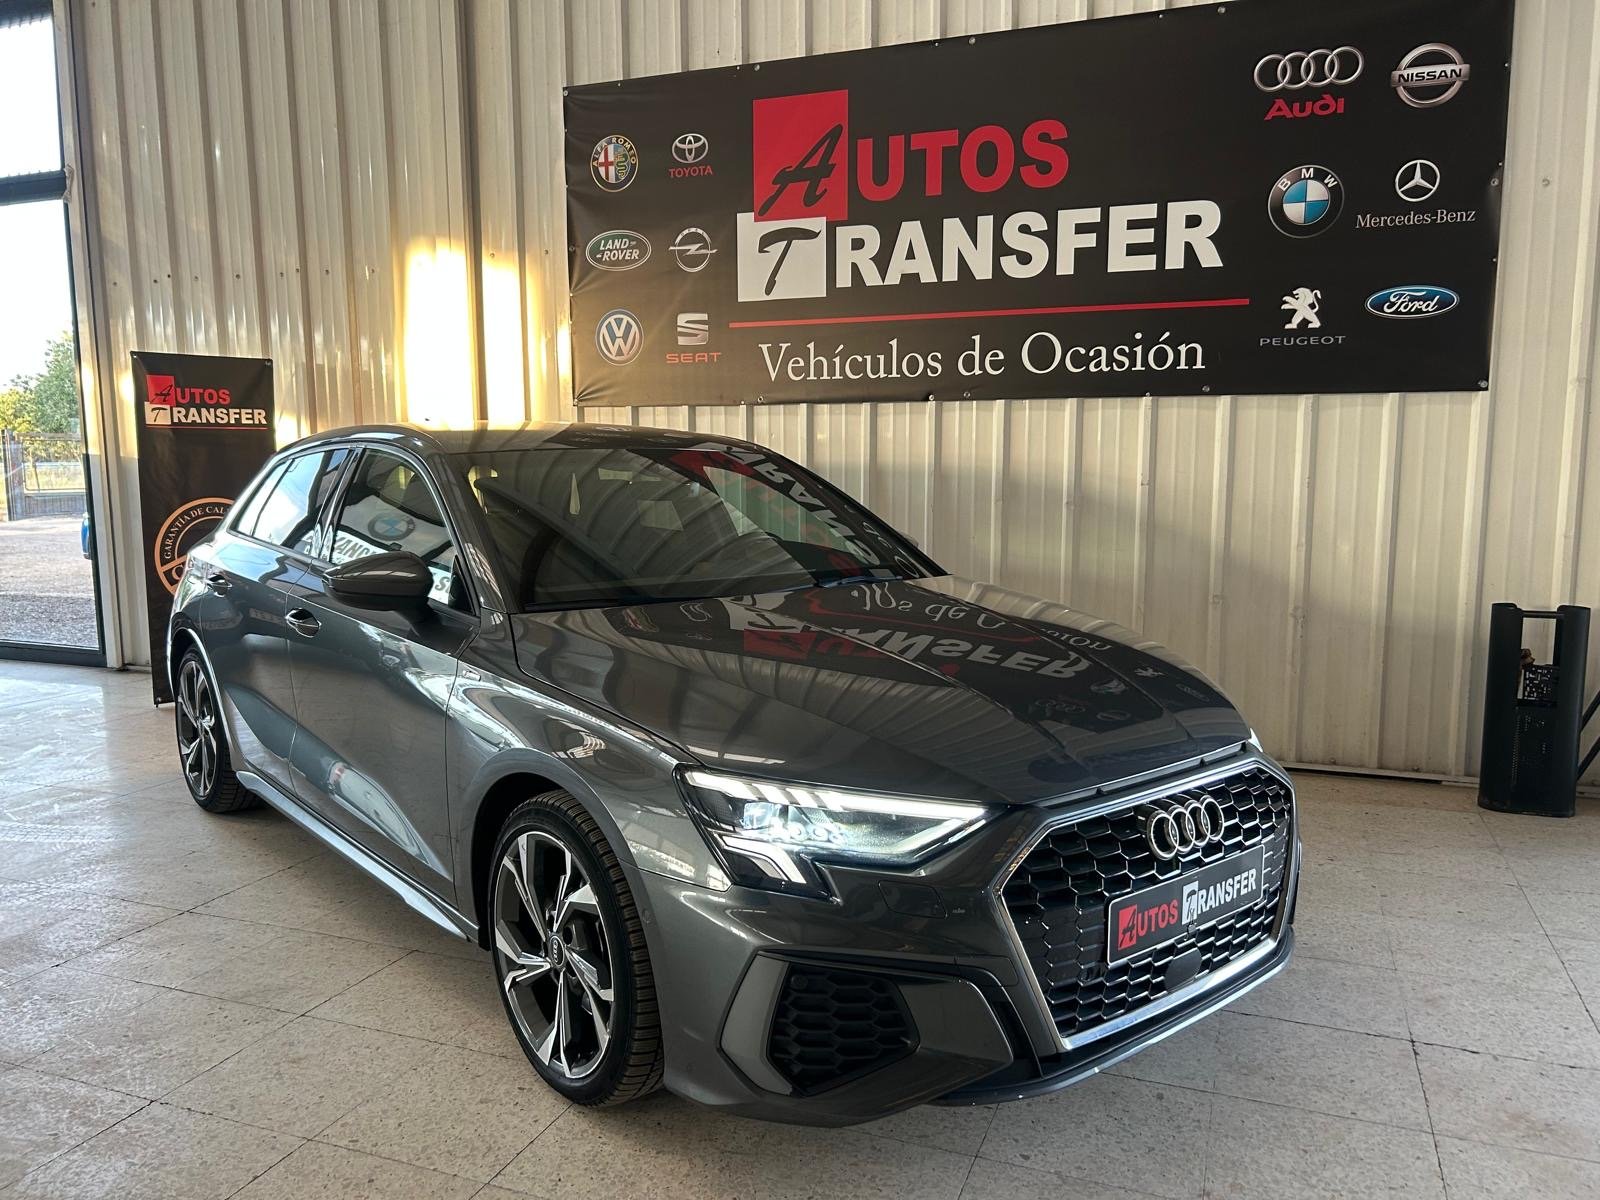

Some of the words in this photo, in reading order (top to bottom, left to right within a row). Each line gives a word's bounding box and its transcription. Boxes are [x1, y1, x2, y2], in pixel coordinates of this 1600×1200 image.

[1397, 68, 1462, 83] NISSAN
[592, 141, 608, 167] ALFA
[611, 137, 637, 164] ROMEO
[668, 165, 713, 178] TOYOTA
[757, 118, 1070, 217] AUTOS
[1278, 167, 1338, 191] BMW
[1355, 208, 1476, 229] Mercedes-Benz
[600, 238, 629, 251] LAND
[602, 249, 640, 261] ROVER
[757, 199, 1224, 296] TRANSFER
[1383, 291, 1439, 314] Ford
[1259, 335, 1347, 347] PEUGEOT
[665, 352, 722, 364] SEAT
[758, 338, 942, 383] Vehículos
[957, 334, 1005, 376] de
[1020, 331, 1206, 375] Ocasión
[151, 384, 231, 405] AUTOS
[150, 406, 268, 425] TRANSFER
[190, 507, 205, 518] DE
[1119, 898, 1179, 949] AUTOS
[1184, 868, 1258, 922] TRANSFER
